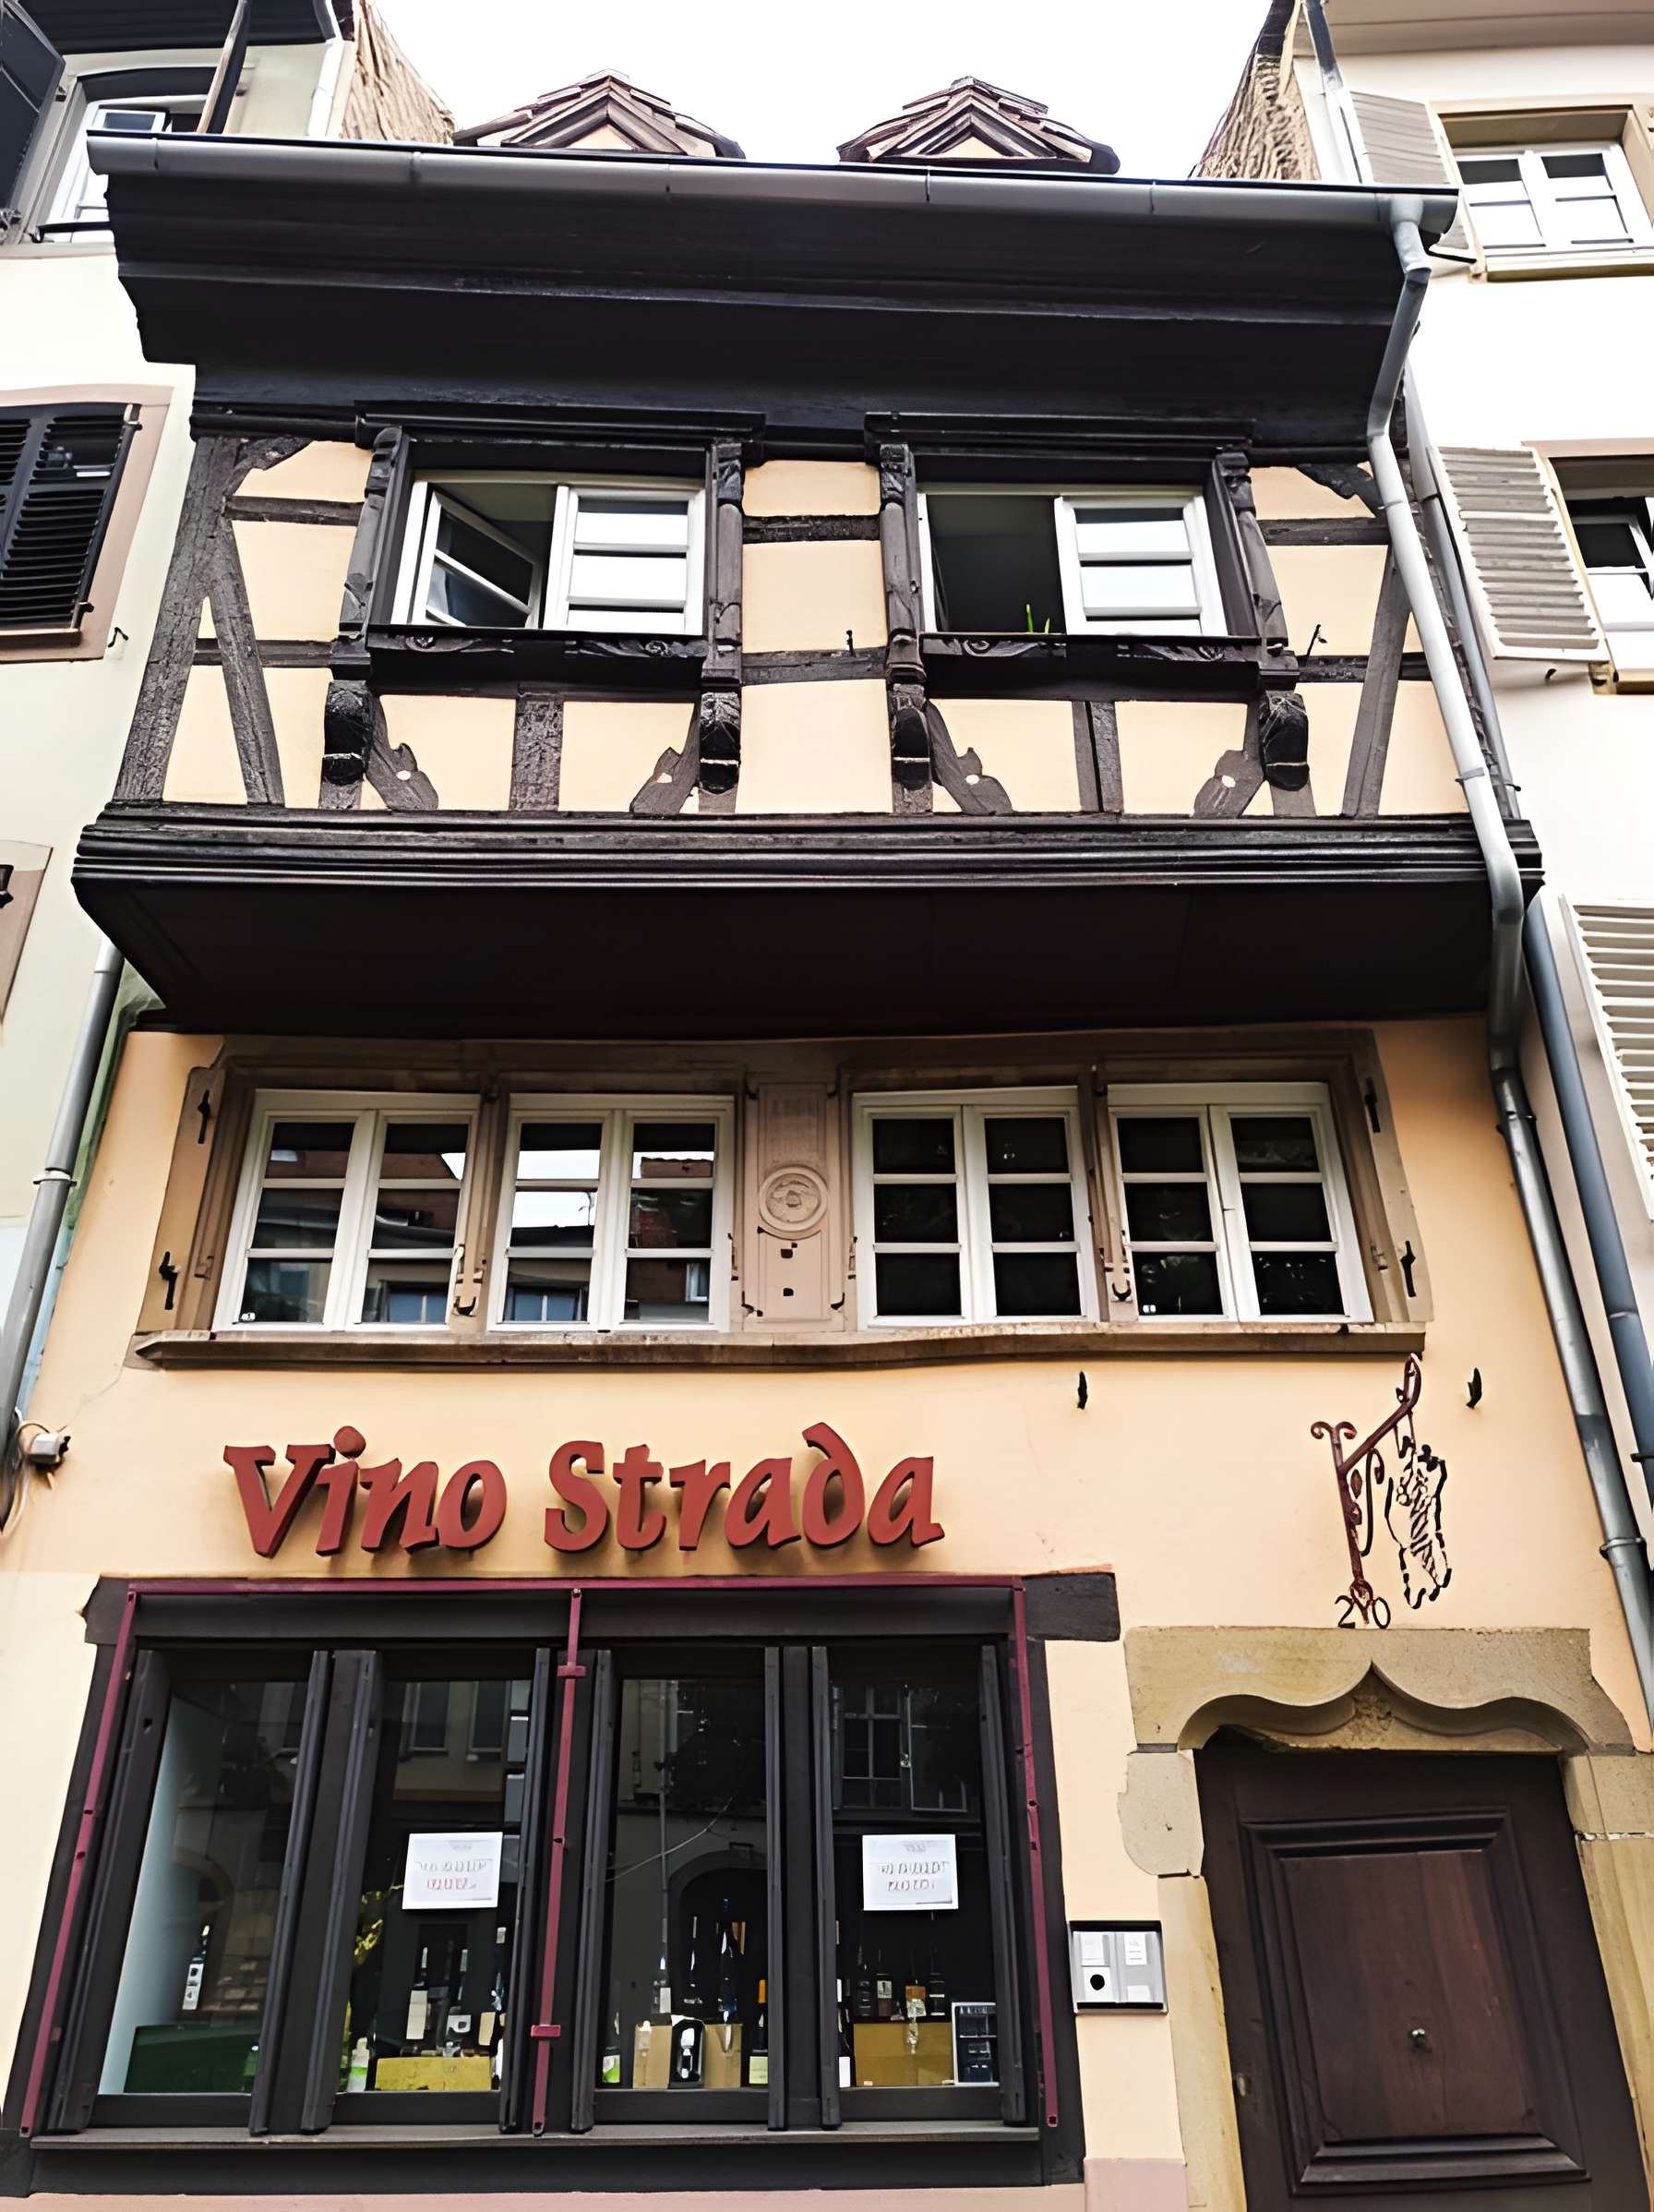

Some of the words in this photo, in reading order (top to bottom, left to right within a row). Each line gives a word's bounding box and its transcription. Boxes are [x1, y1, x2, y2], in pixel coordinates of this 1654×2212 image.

[223, 1425, 507, 1557] Vino
[545, 1422, 944, 1552] Strada
[1335, 1595, 1391, 1629] 20
